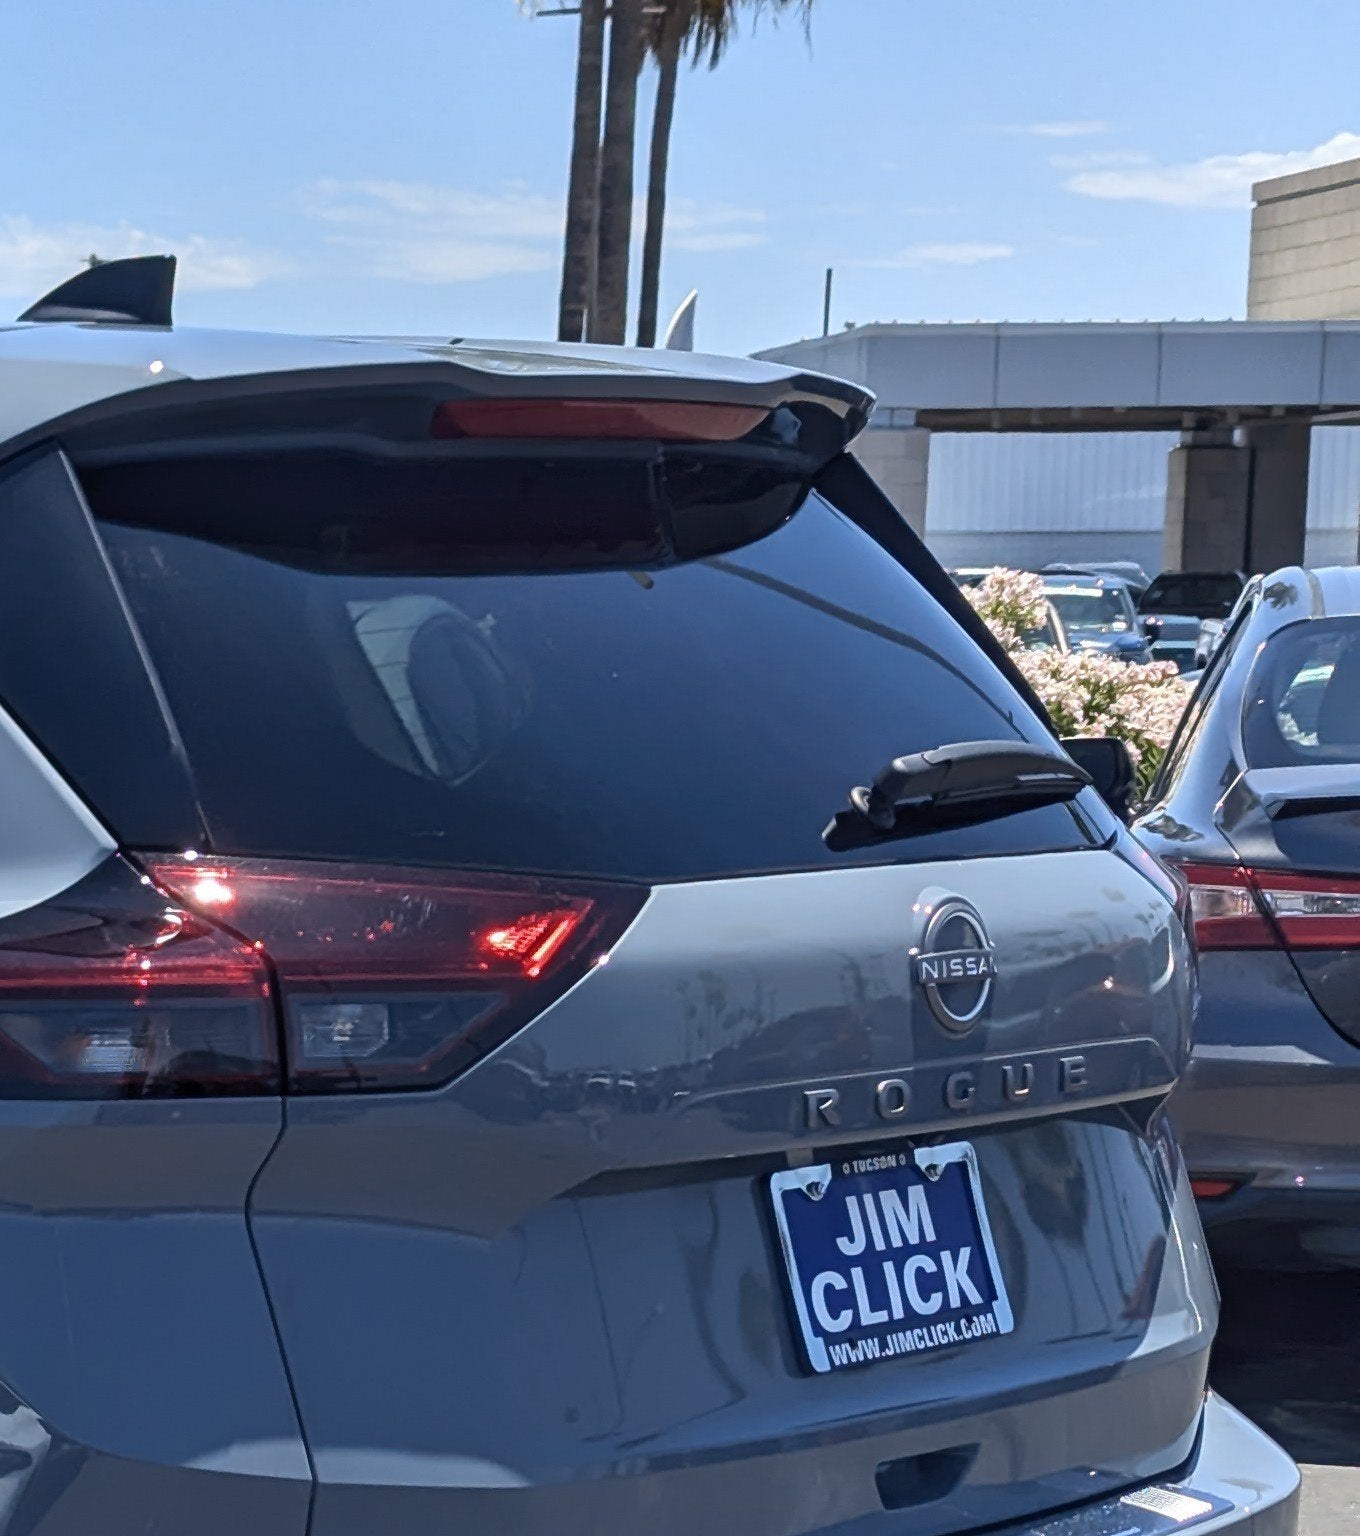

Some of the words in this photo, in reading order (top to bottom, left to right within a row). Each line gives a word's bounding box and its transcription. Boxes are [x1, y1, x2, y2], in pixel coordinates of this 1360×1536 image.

[803, 1055, 1088, 1130] ROGUE
[851, 1153, 898, 1174] TUCSON
[835, 1184, 937, 1256] JIM
[810, 1246, 984, 1333] CLICK
[829, 1312, 998, 1367] WWW.JIMCLICK.COM
